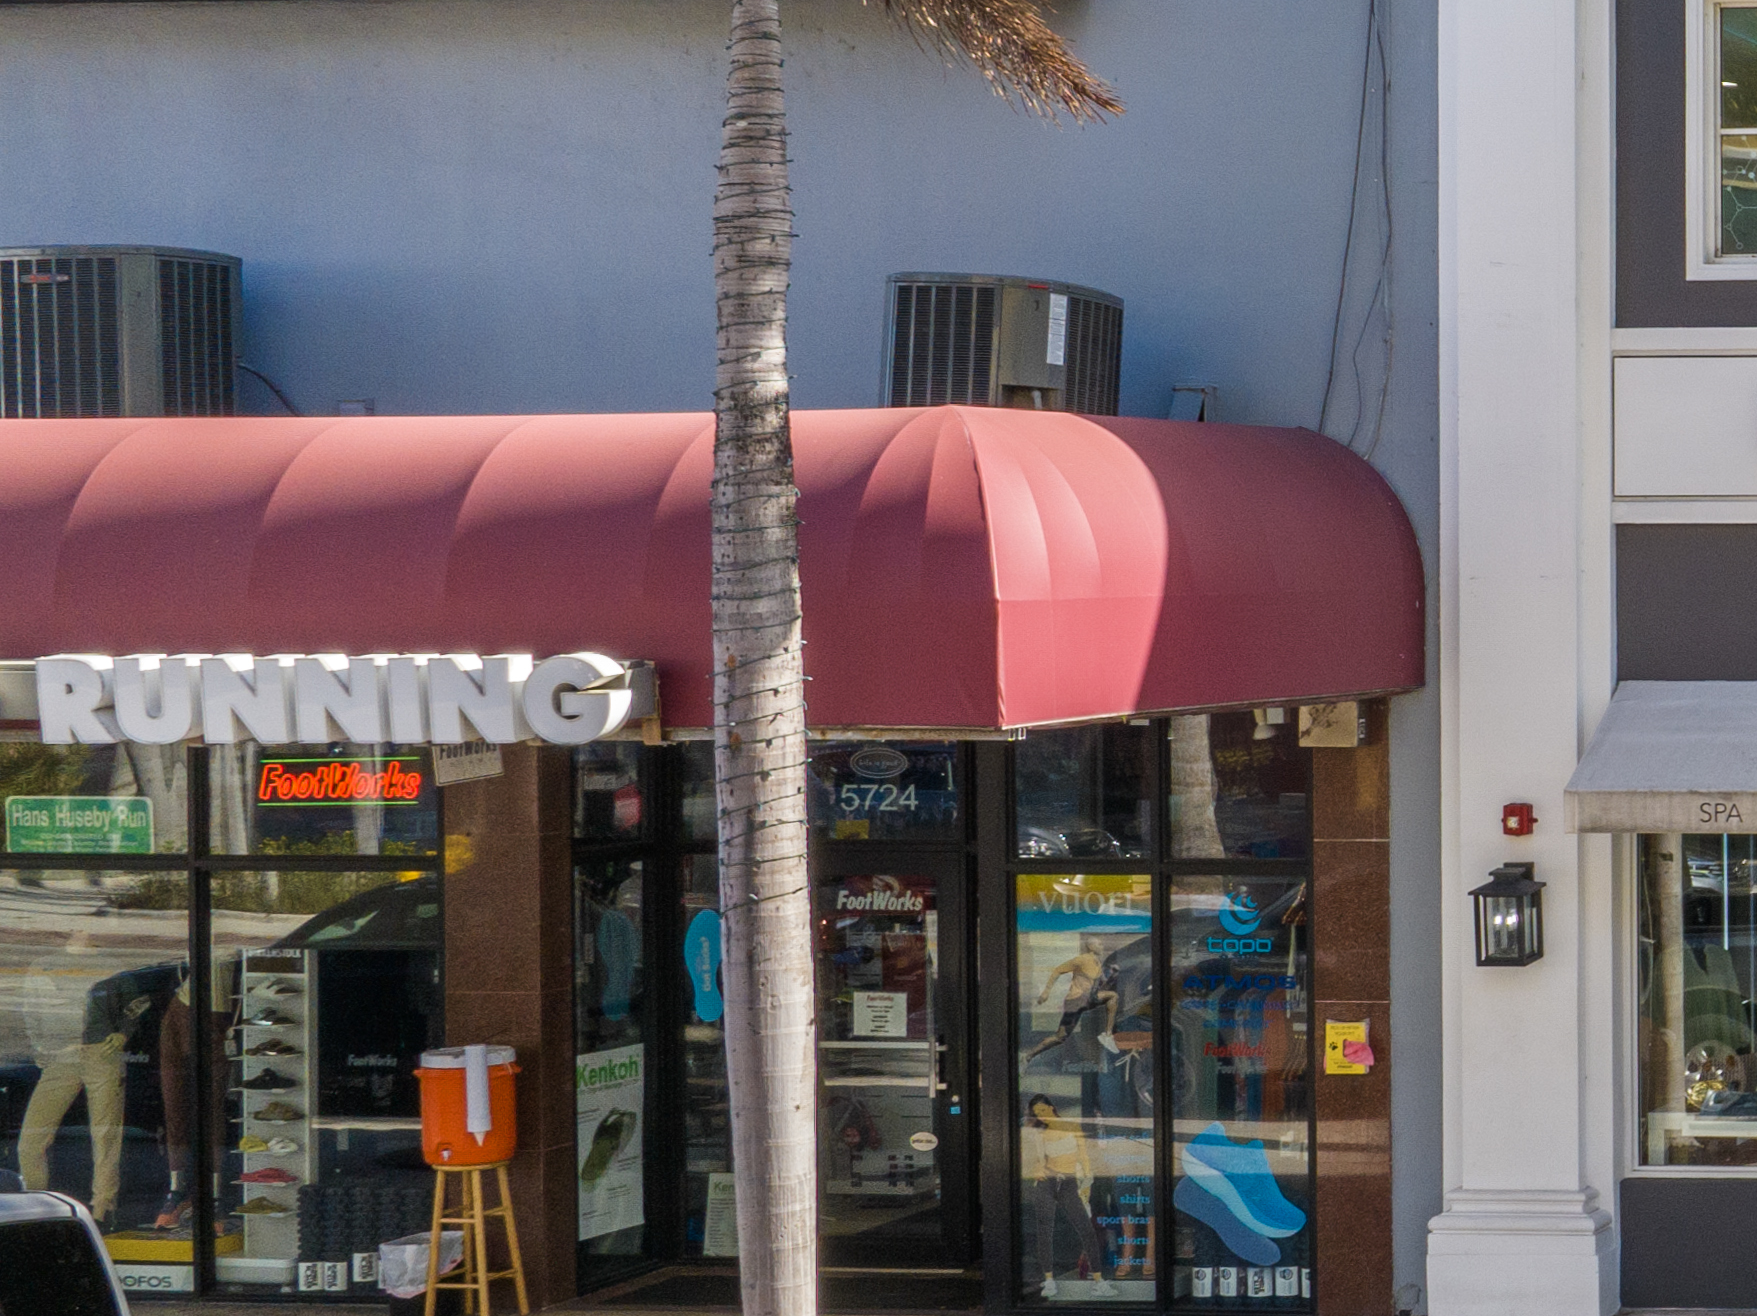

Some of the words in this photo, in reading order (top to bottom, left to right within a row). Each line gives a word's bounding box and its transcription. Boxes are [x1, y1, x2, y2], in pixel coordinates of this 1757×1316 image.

[37, 653, 632, 745] RUNNING
[258, 760, 422, 801] FootWorks
[840, 784, 919, 811] 5724
[12, 804, 49, 827] Hans
[55, 804, 111, 831] Huseby
[117, 805, 147, 827] Run
[1699, 802, 1744, 823] SPA
[836, 889, 925, 911] FootWorks
[1206, 936, 1272, 955] topo
[576, 1055, 640, 1089] Kenkoh
